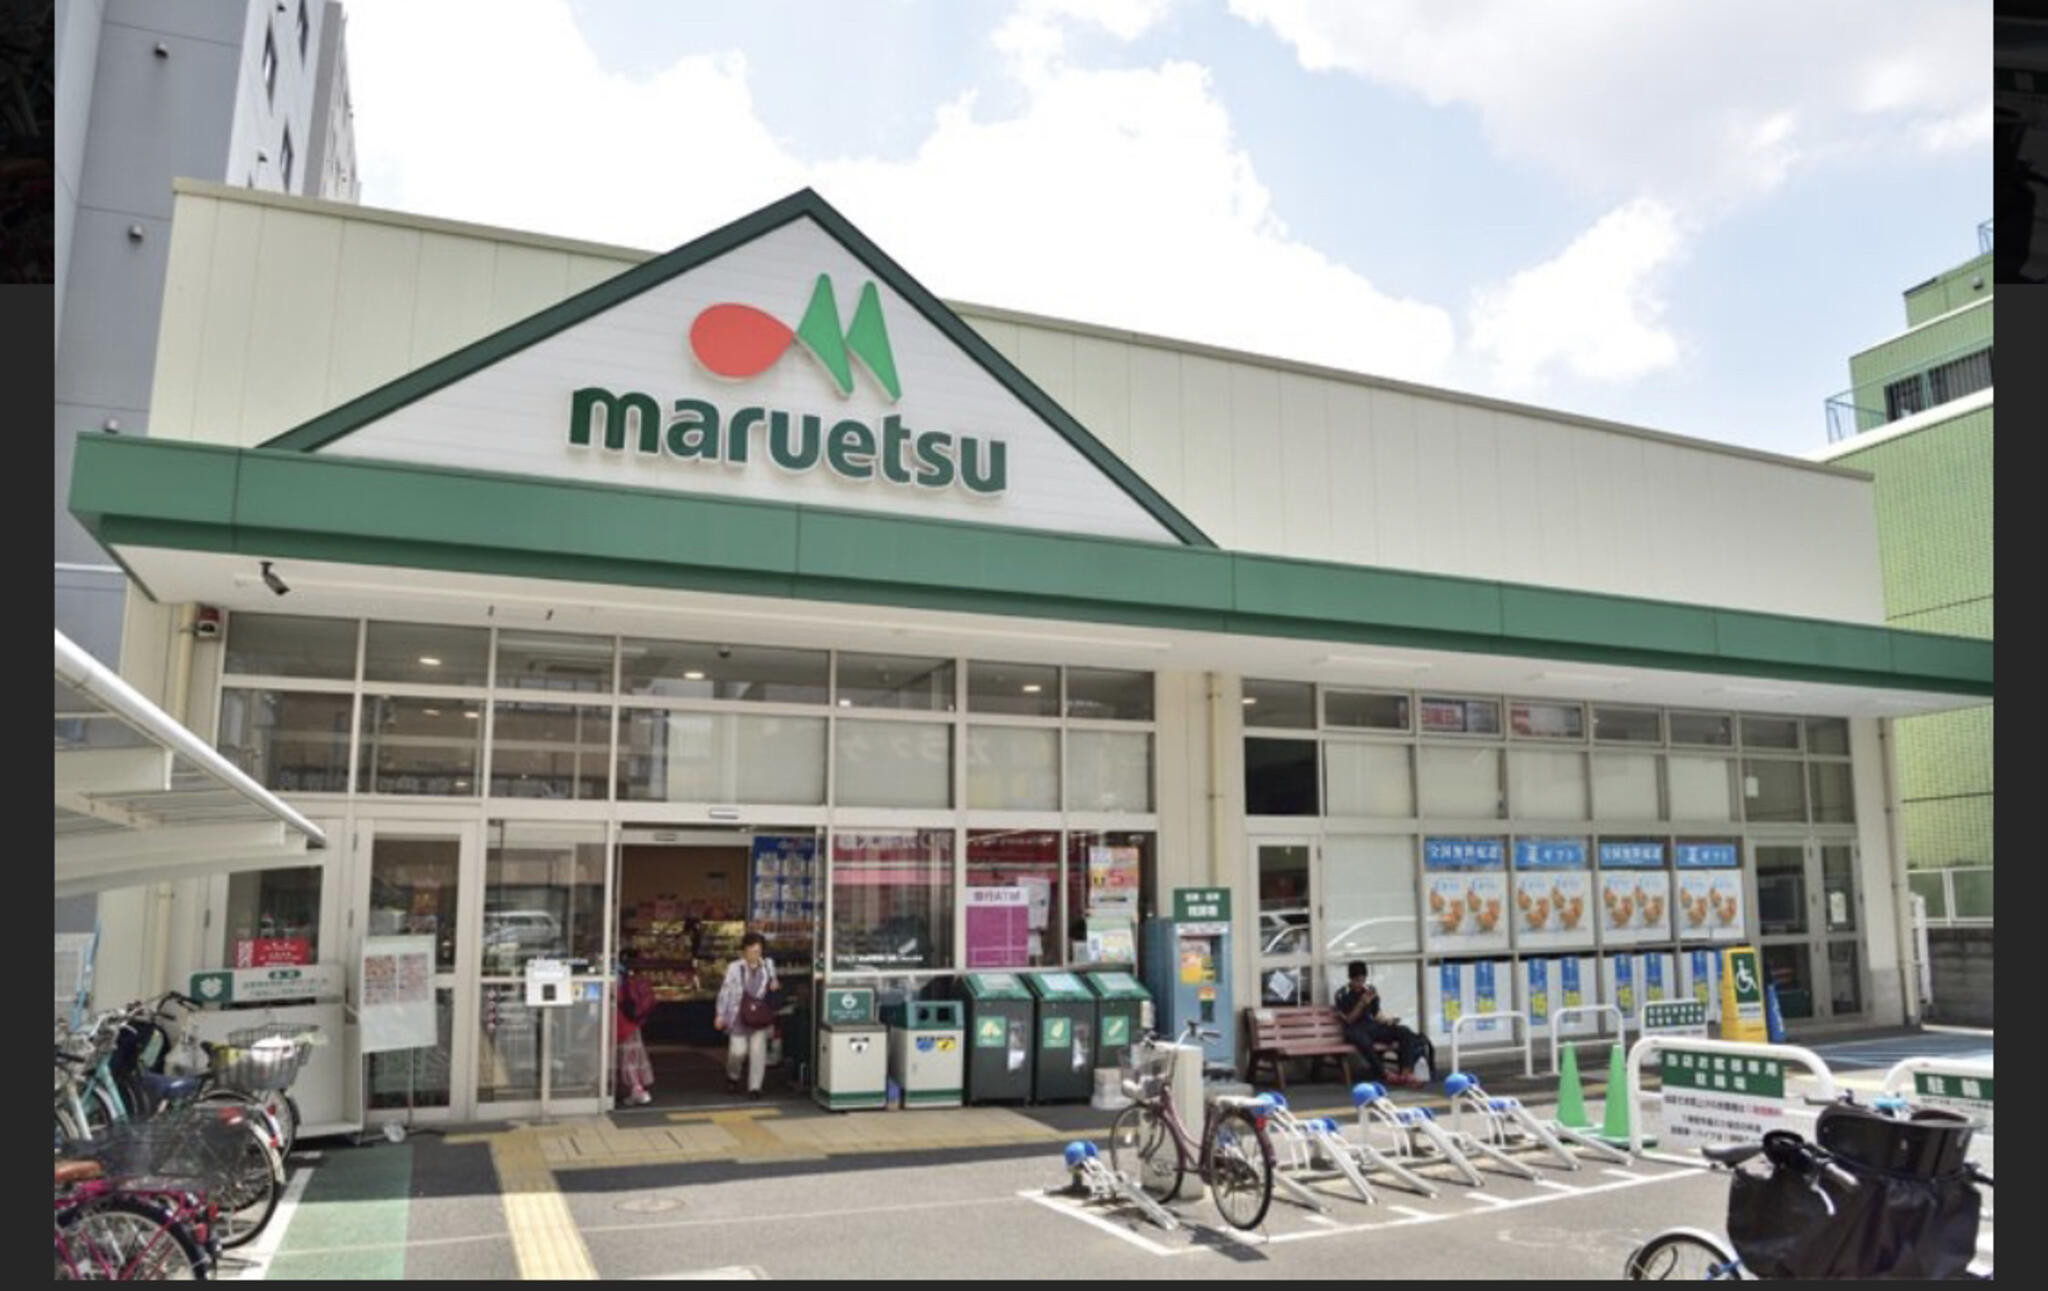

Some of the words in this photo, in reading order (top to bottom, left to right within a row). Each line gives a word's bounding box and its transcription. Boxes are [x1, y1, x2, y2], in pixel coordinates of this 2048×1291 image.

[569, 386, 1007, 494] maruetsu
[1666, 1053, 1778, 1077] 当店お客様専用
